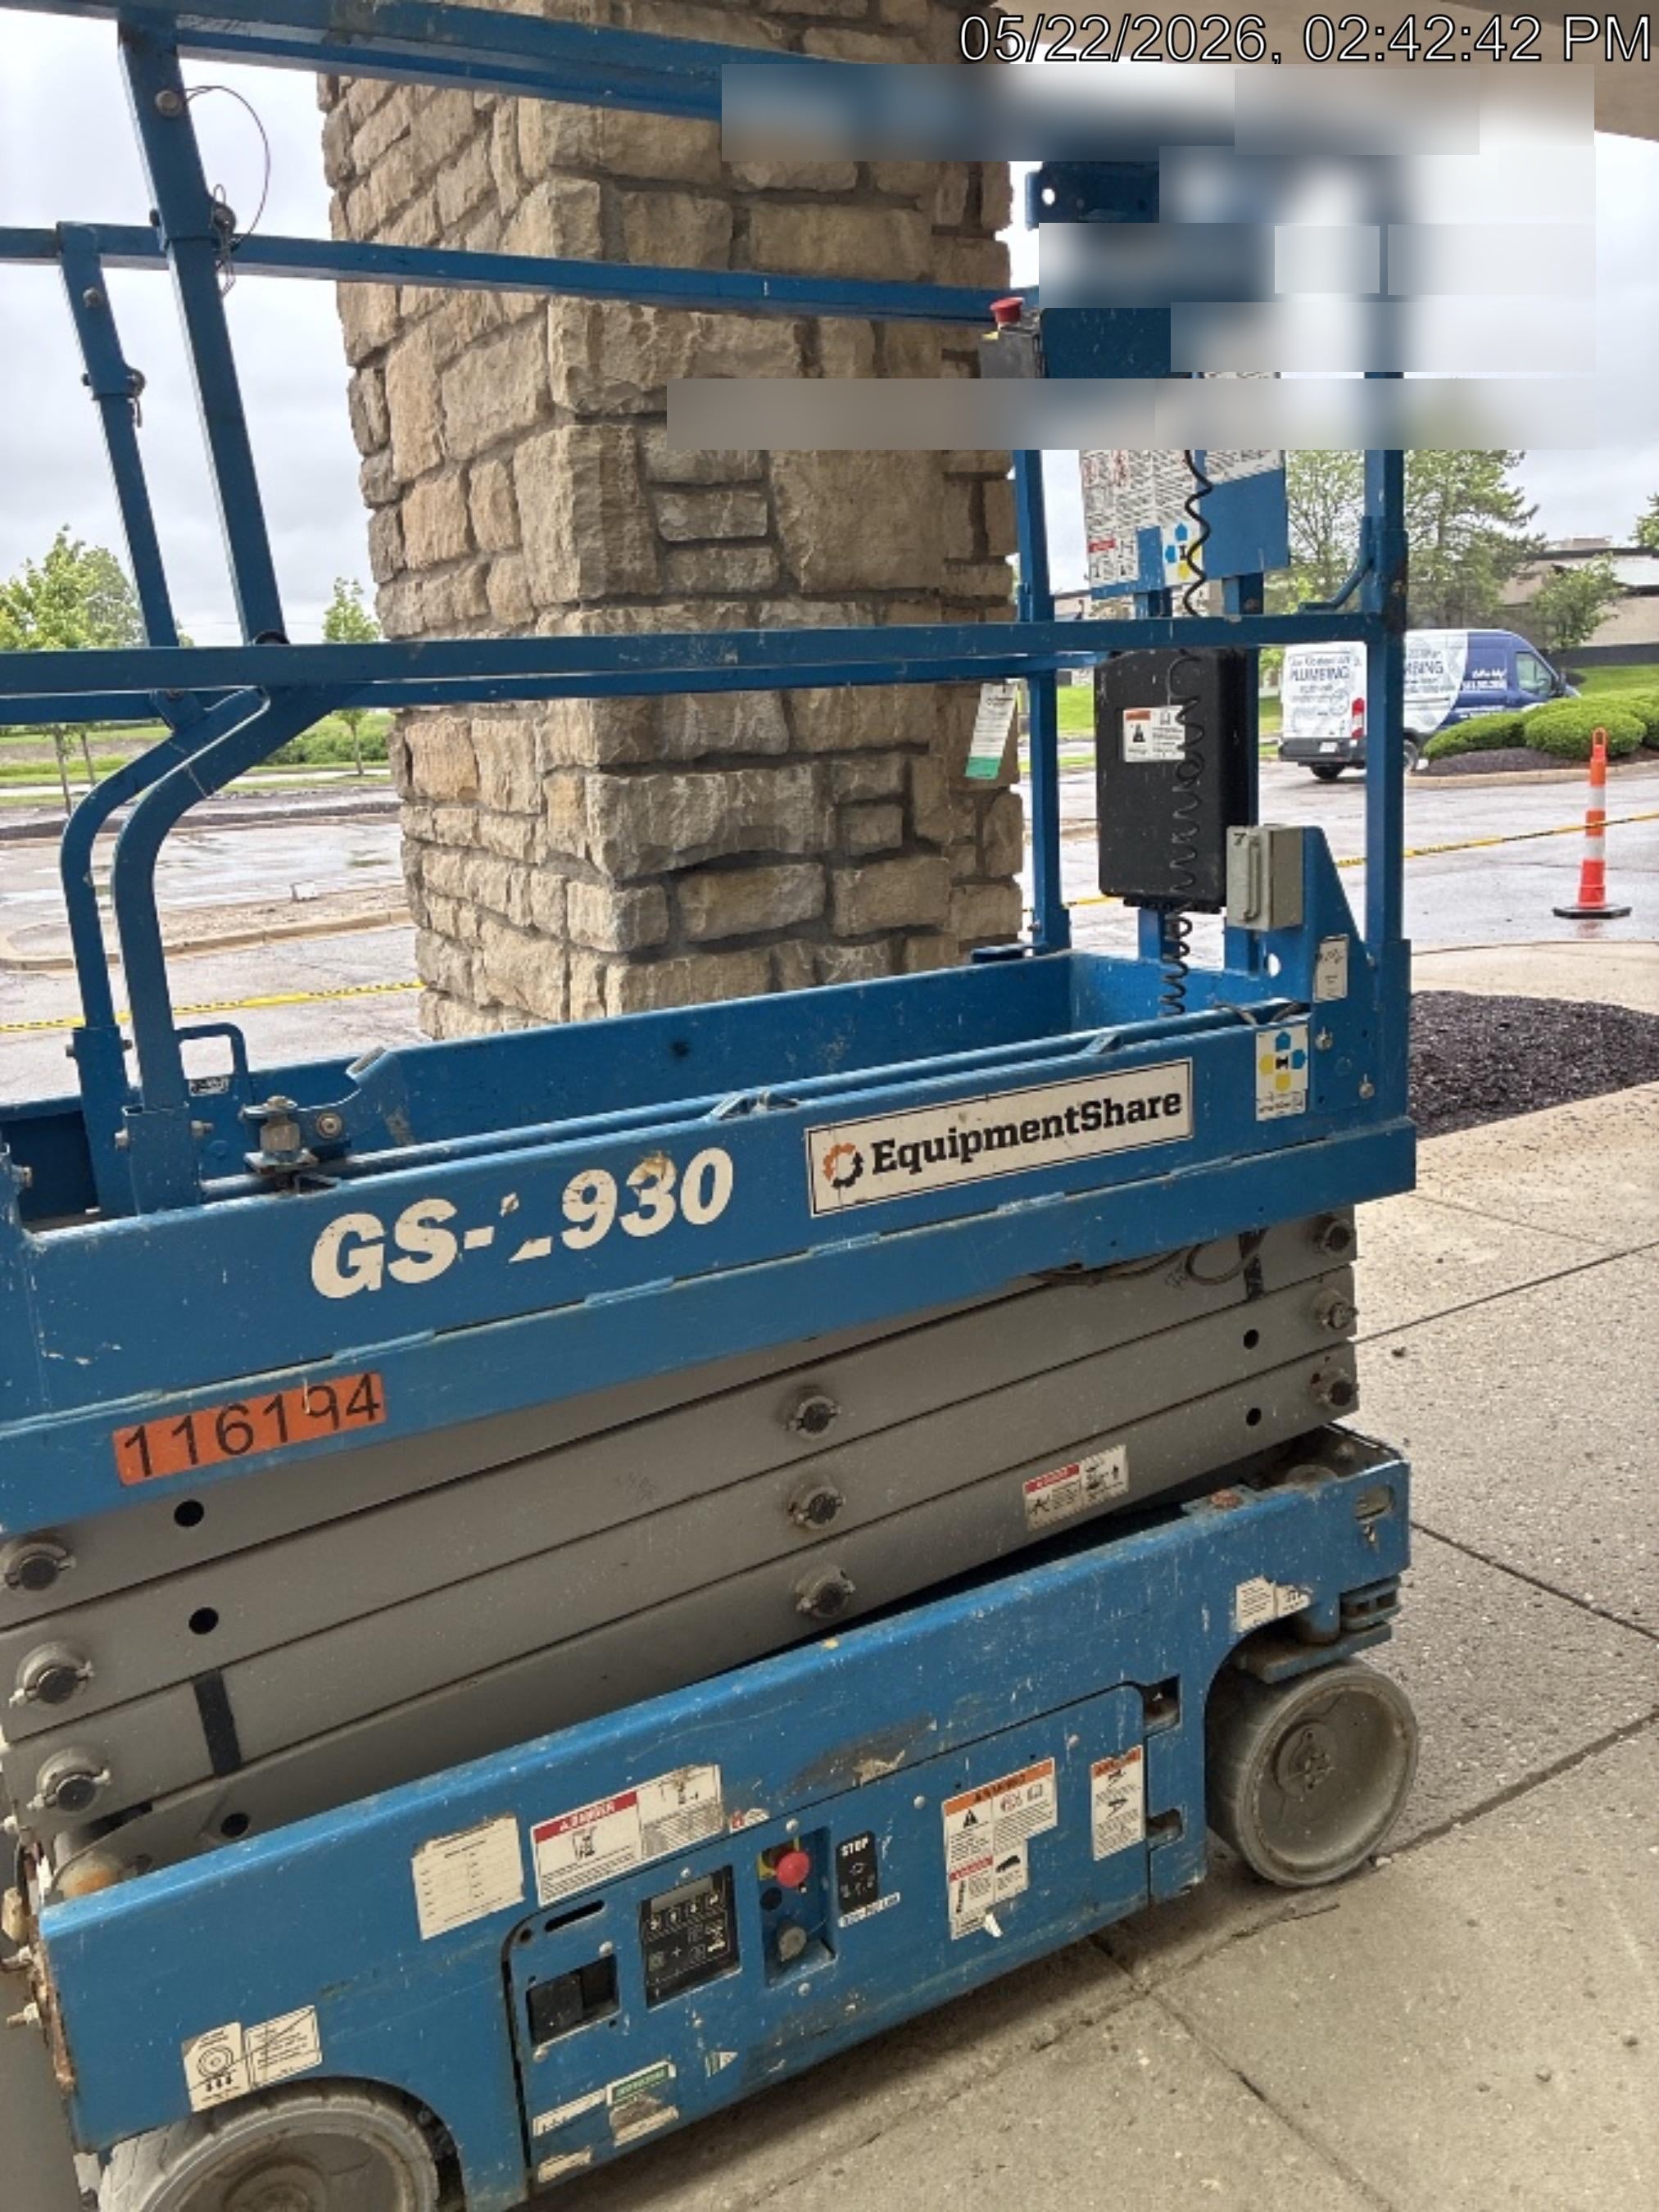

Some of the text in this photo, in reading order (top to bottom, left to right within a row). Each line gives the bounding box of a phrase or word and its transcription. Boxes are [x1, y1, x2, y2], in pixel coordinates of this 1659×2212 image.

[871, 1091, 1181, 1176] EquipmentShare
[124, 1372, 381, 1477] 116194
[841, 1835, 868, 1857] STOP
